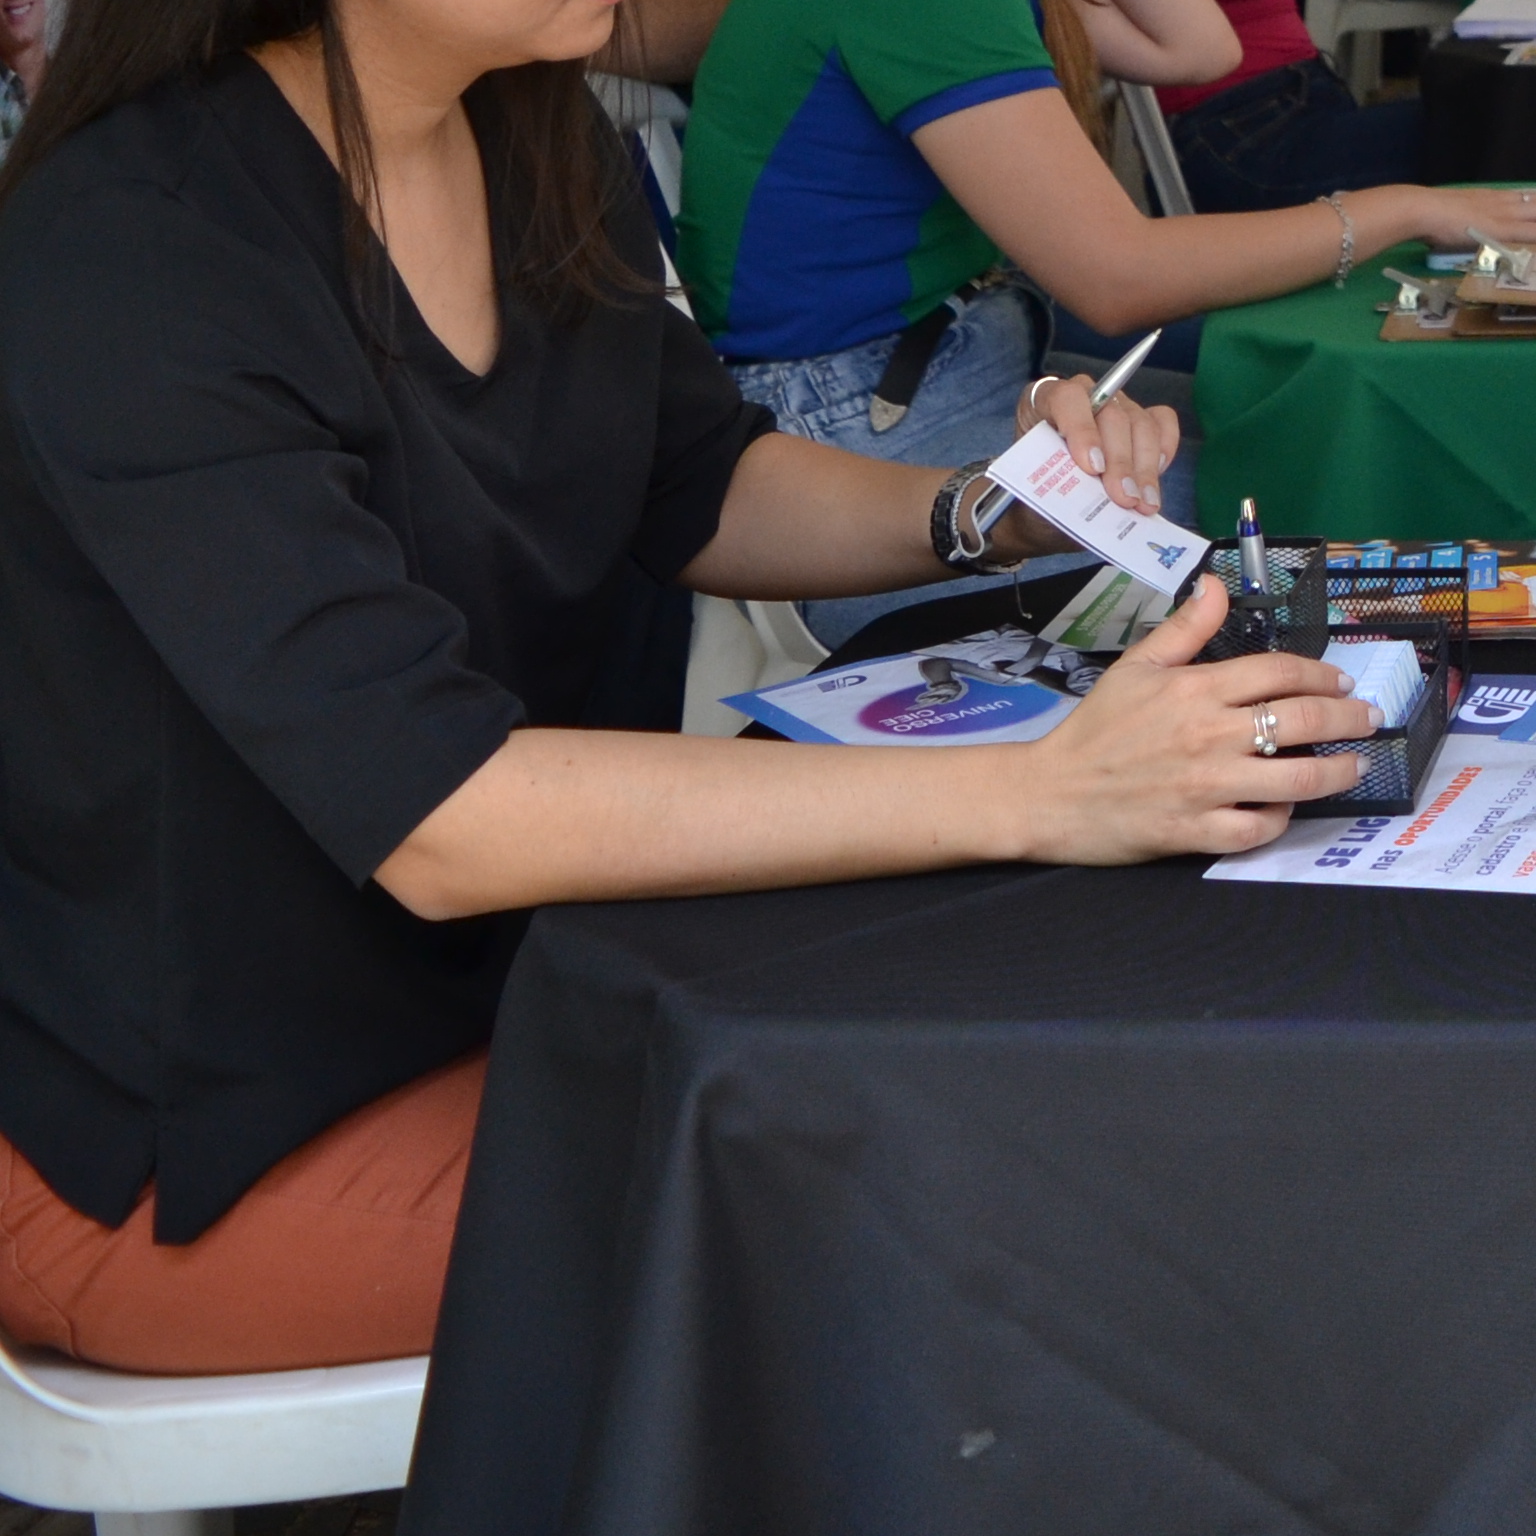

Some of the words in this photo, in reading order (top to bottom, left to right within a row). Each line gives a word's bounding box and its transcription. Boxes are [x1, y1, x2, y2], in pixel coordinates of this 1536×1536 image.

[879, 709, 935, 726] CIEE
[892, 700, 1013, 732] UNIVERSO
[1369, 849, 1404, 870] nas
[1394, 766, 1483, 847] OPORTUNIDADES
[1314, 846, 1362, 868] SE
[1339, 816, 1392, 857] LIG
[1435, 840, 1476, 874] Acesse
[1476, 834, 1521, 876] cadastro
